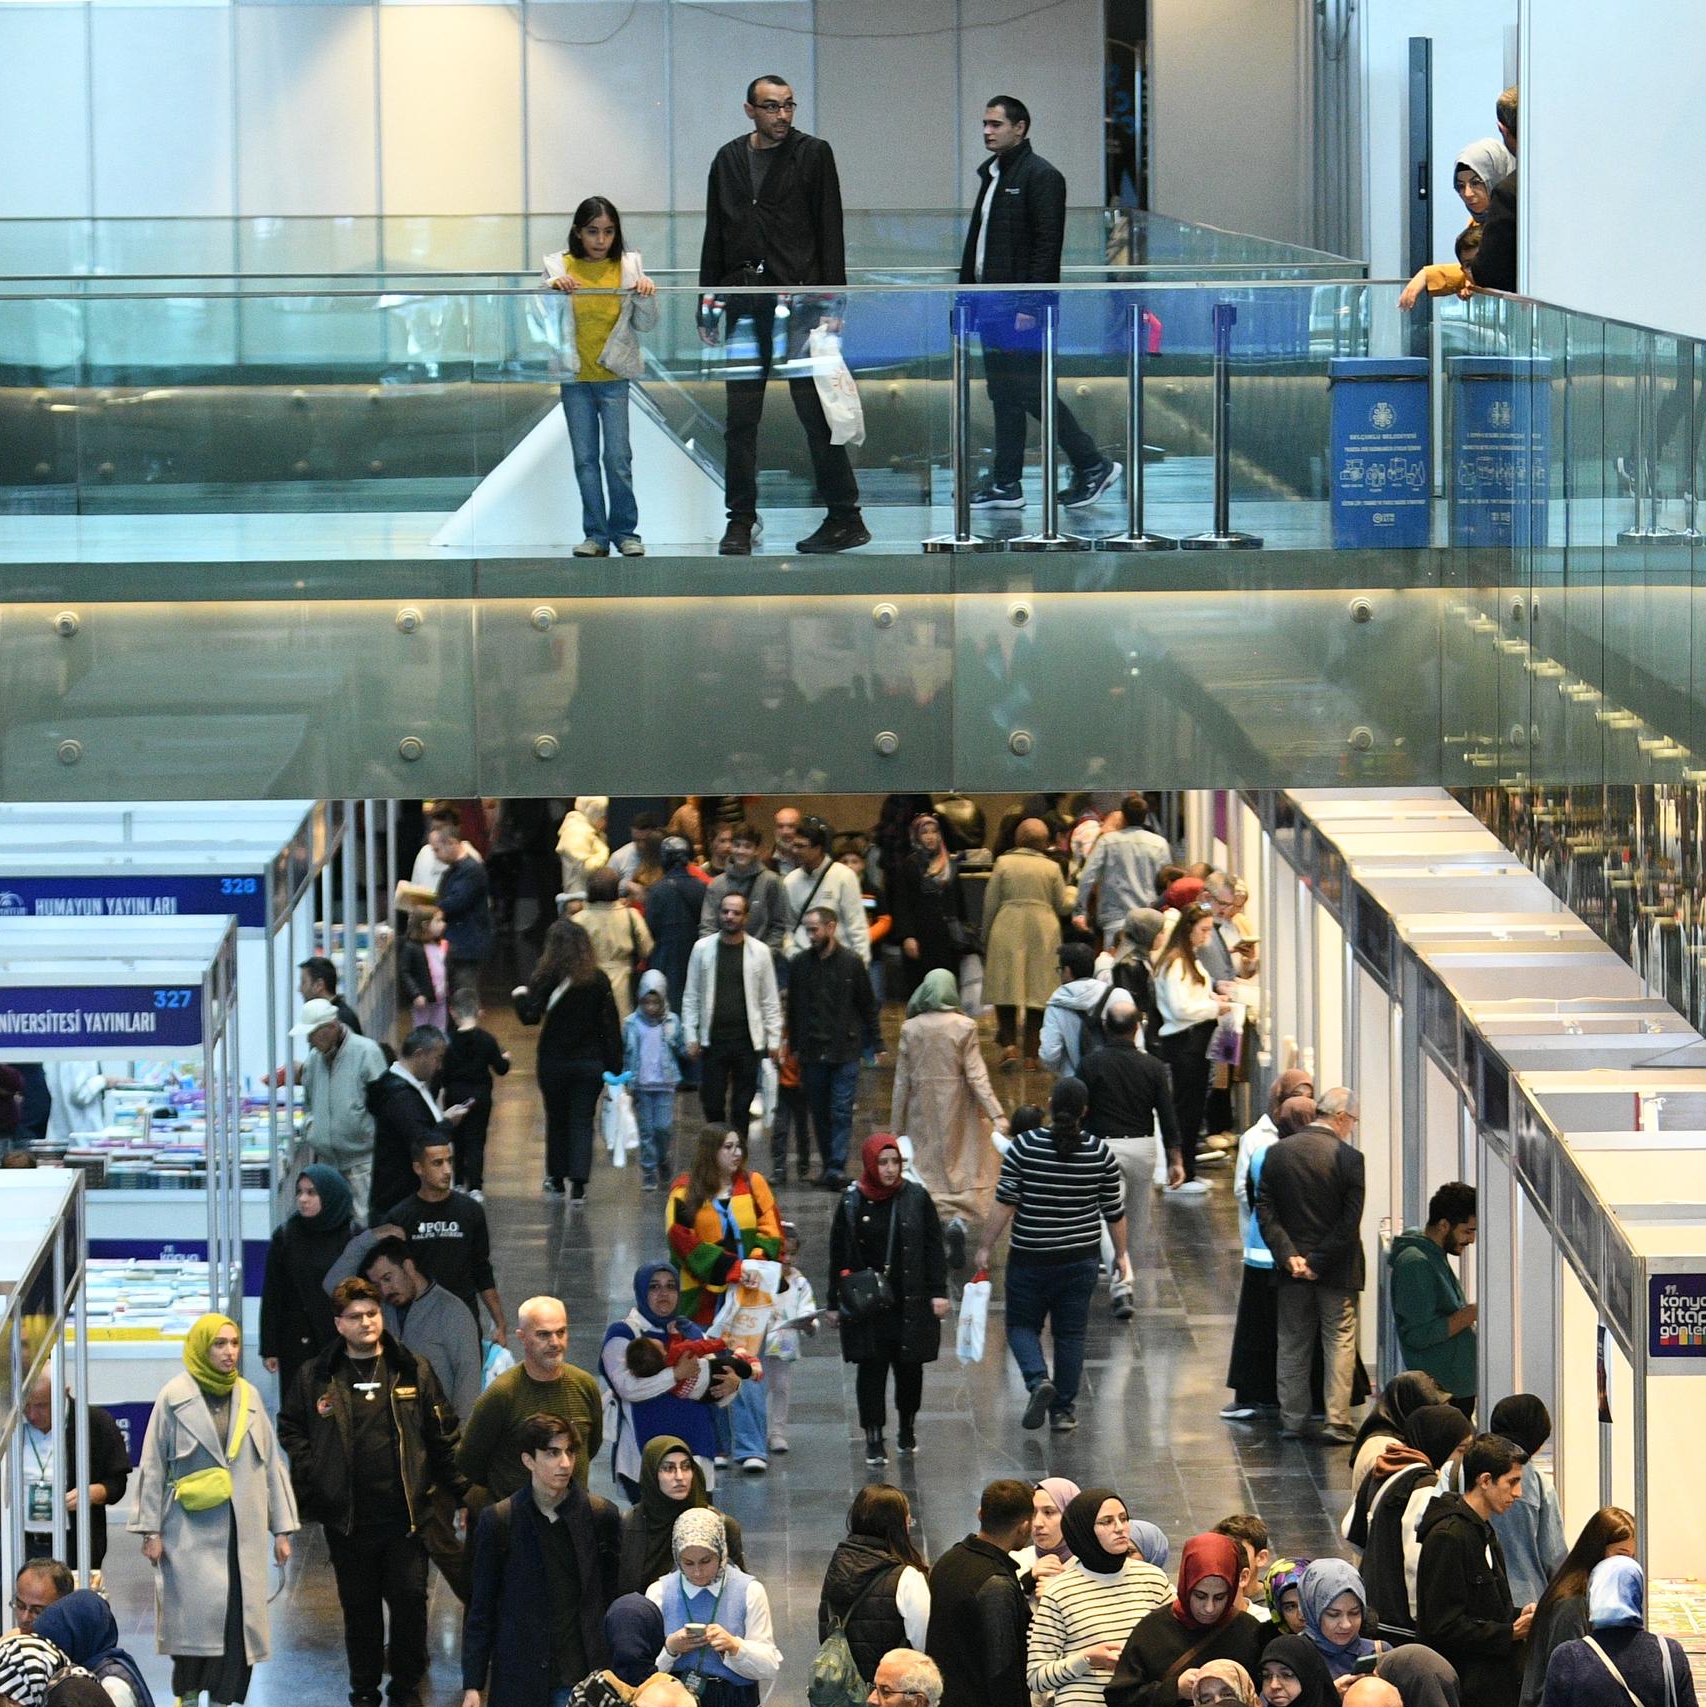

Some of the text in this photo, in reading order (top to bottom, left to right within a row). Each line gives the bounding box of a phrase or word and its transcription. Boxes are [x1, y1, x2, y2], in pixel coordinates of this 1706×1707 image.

[220, 879, 256, 895] 328
[154, 991, 191, 1008] 327
[83, 1011, 157, 1033] YAYINLARI
[426, 1221, 459, 1232] POLO
